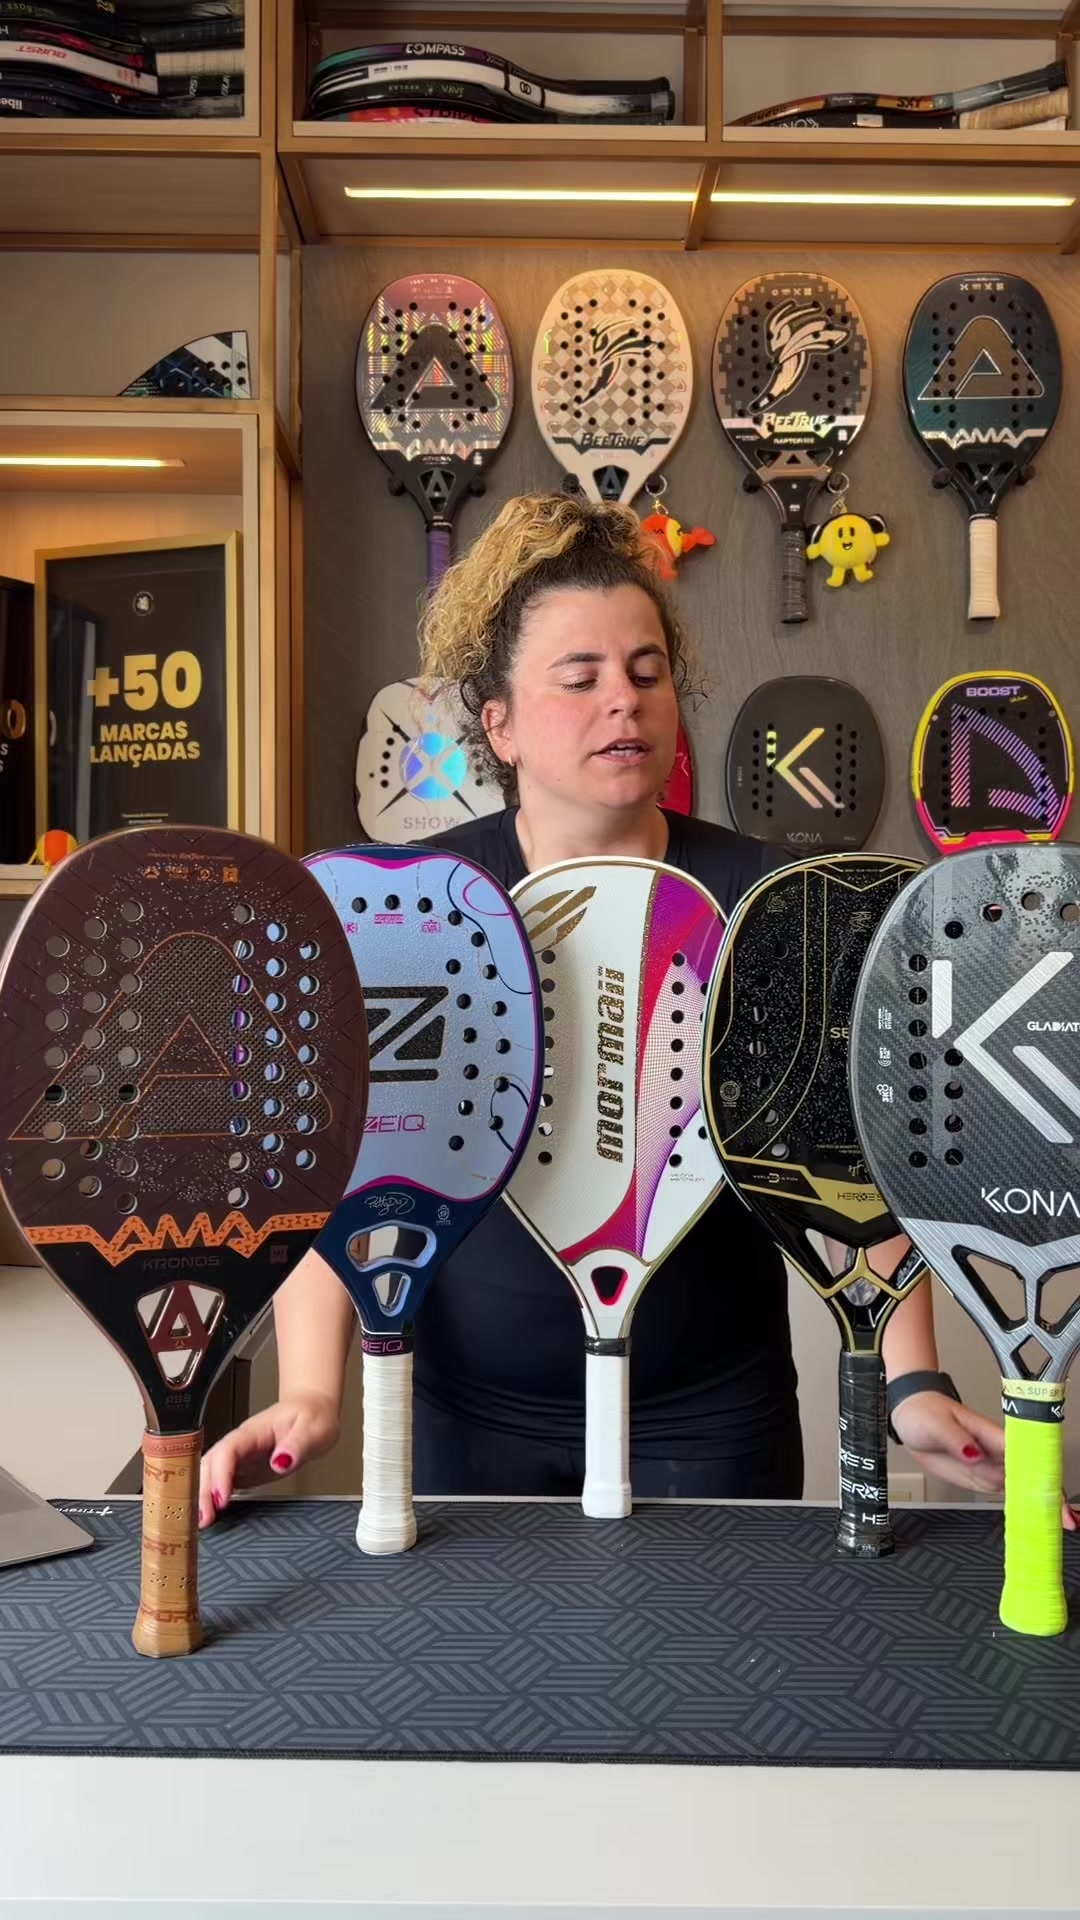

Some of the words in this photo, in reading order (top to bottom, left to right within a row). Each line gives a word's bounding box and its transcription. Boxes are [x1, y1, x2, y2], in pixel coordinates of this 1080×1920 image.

[406, 43, 466, 56] COMPASS
[87, 650, 202, 711] +50
[966, 685, 1021, 697] BOOST
[100, 720, 189, 743] MARCAS
[89, 741, 201, 768] LANÇADAS
[786, 832, 823, 843] KONA
[1027, 1021, 1080, 1032] GLADIAT
[597, 966, 625, 1164] mormaii
[363, 1114, 425, 1134] ZEIQ
[981, 1187, 1080, 1218] KONA
[143, 1255, 220, 1270] KRONOS
